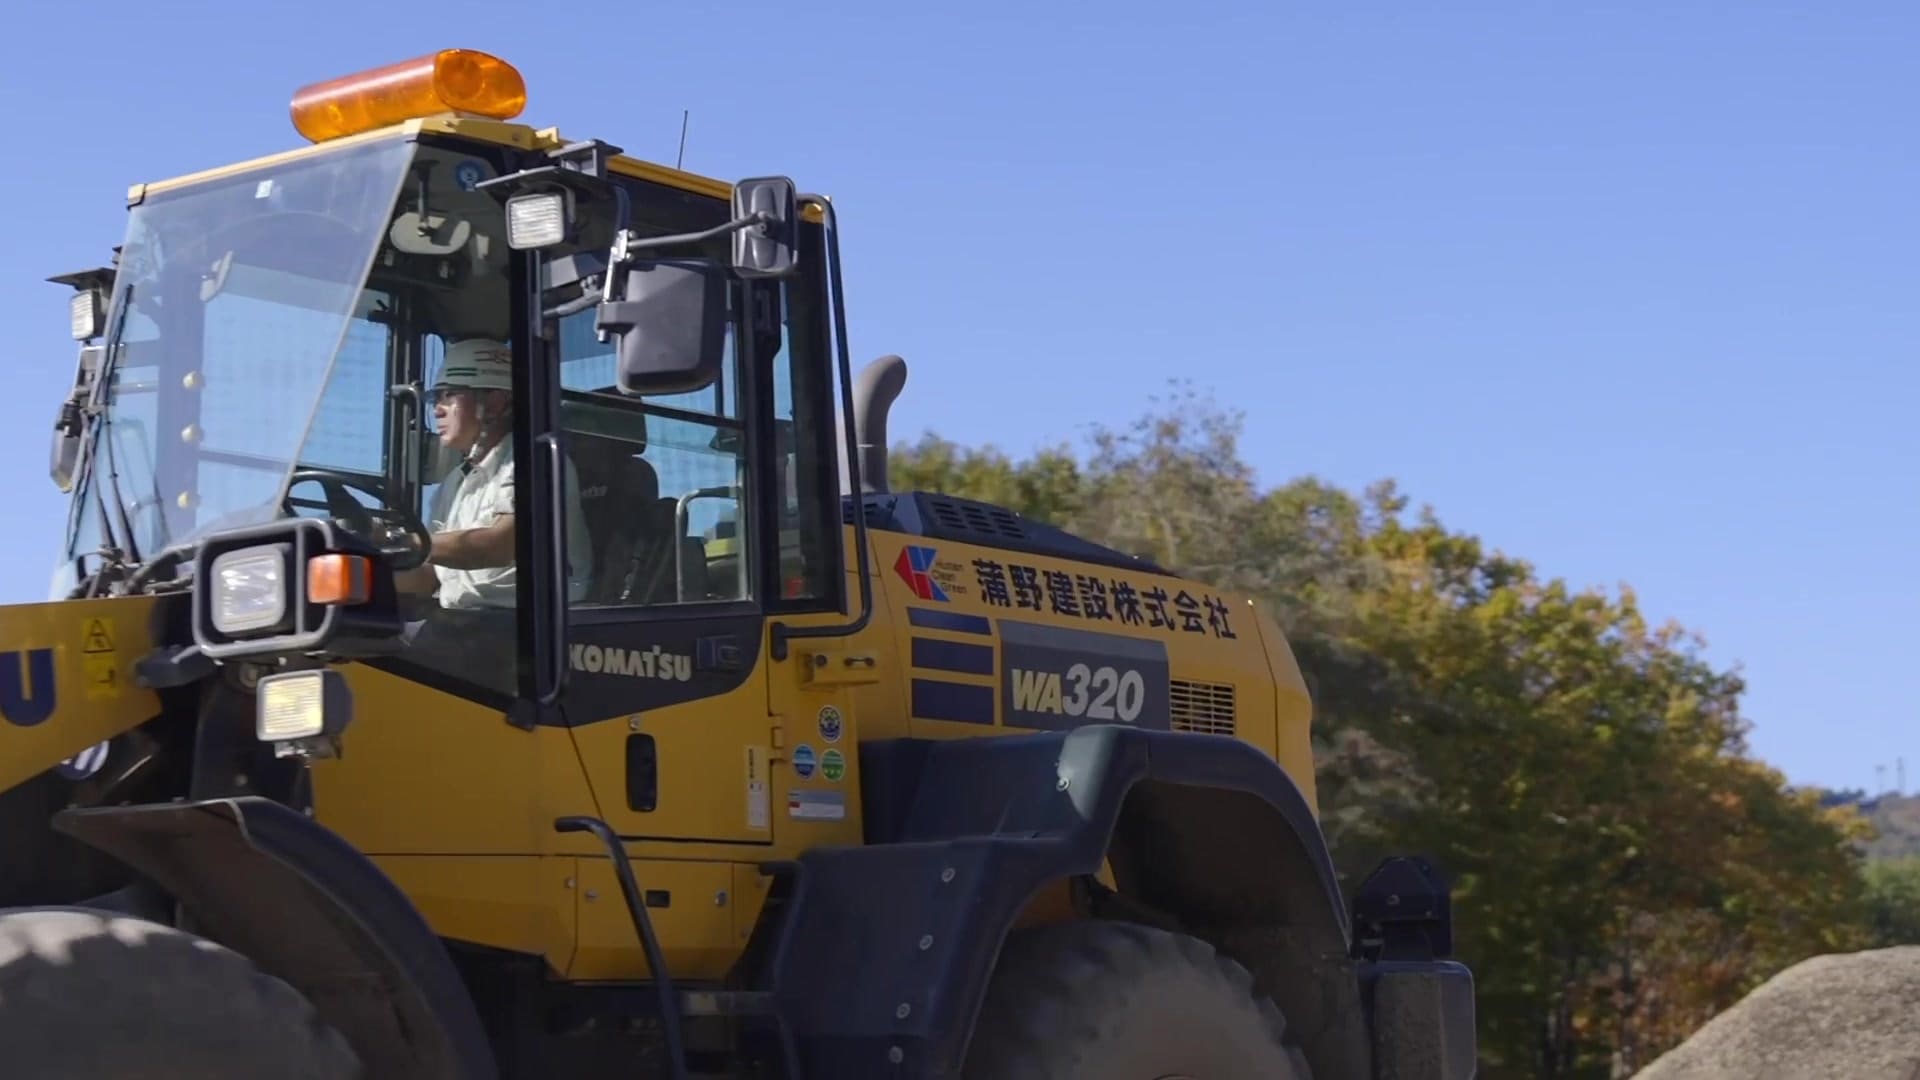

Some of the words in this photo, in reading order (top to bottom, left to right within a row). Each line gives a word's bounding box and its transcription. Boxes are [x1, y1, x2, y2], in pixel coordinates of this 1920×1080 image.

[971, 559, 1236, 639] 蒲野建設株式会社
[569, 643, 692, 682] KOMATSU
[1011, 663, 1145, 722] WA320
